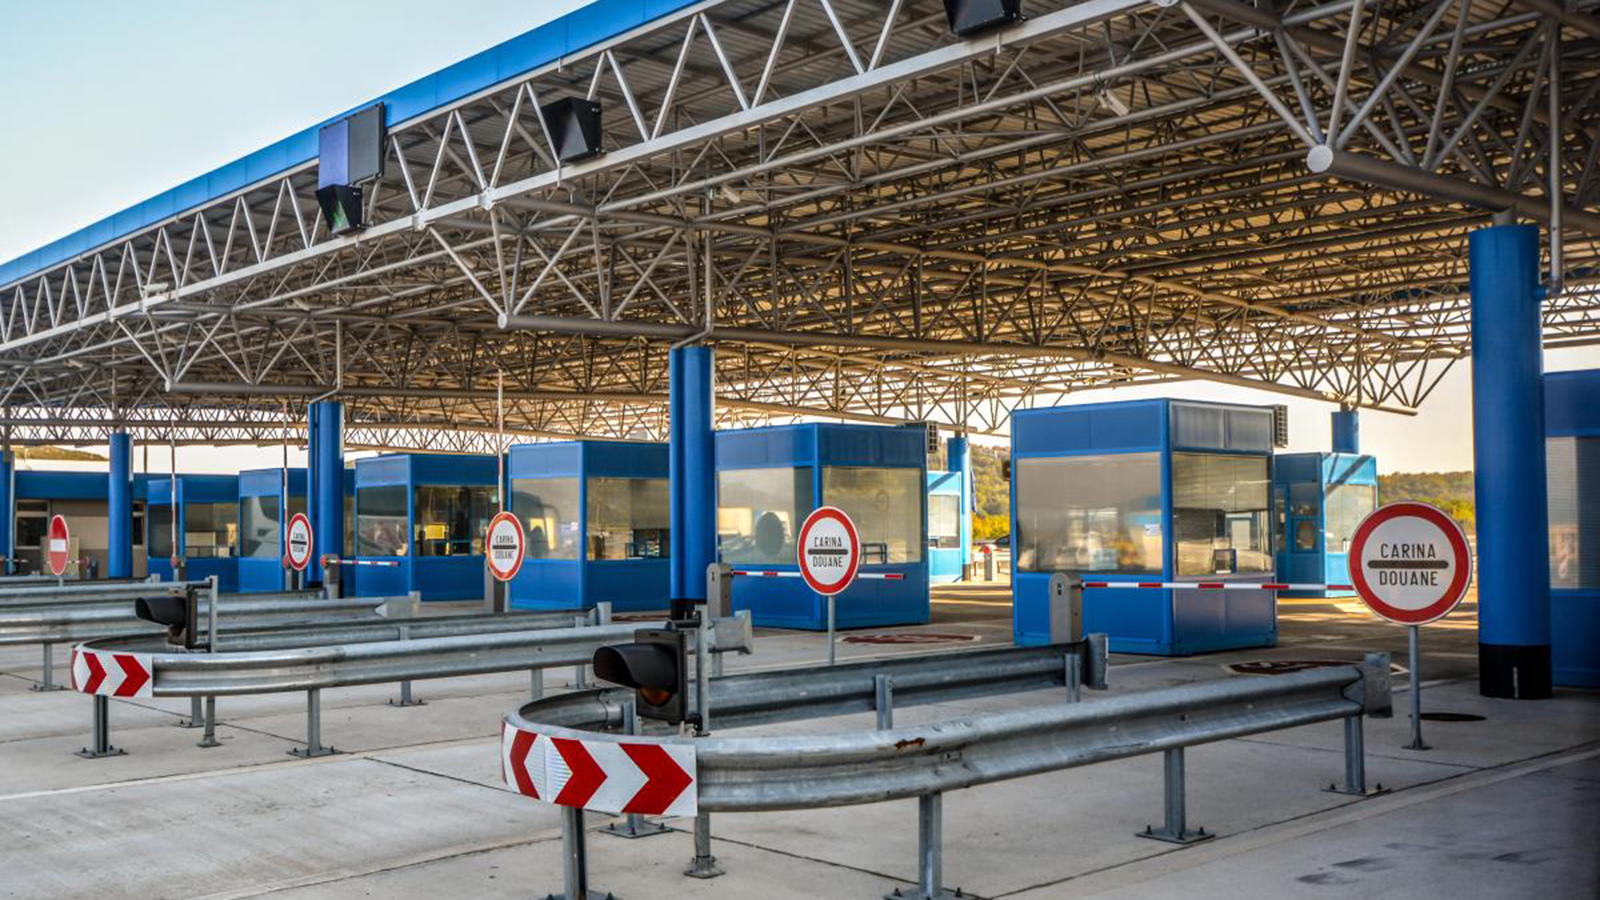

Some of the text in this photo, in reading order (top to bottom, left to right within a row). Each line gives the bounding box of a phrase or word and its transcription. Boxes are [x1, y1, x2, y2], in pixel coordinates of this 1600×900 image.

[814, 536, 842, 547] CARINA
[1380, 543, 1436, 559] CARINA
[812, 556, 843, 567] DOUANE
[1379, 570, 1438, 586] DOUANE
